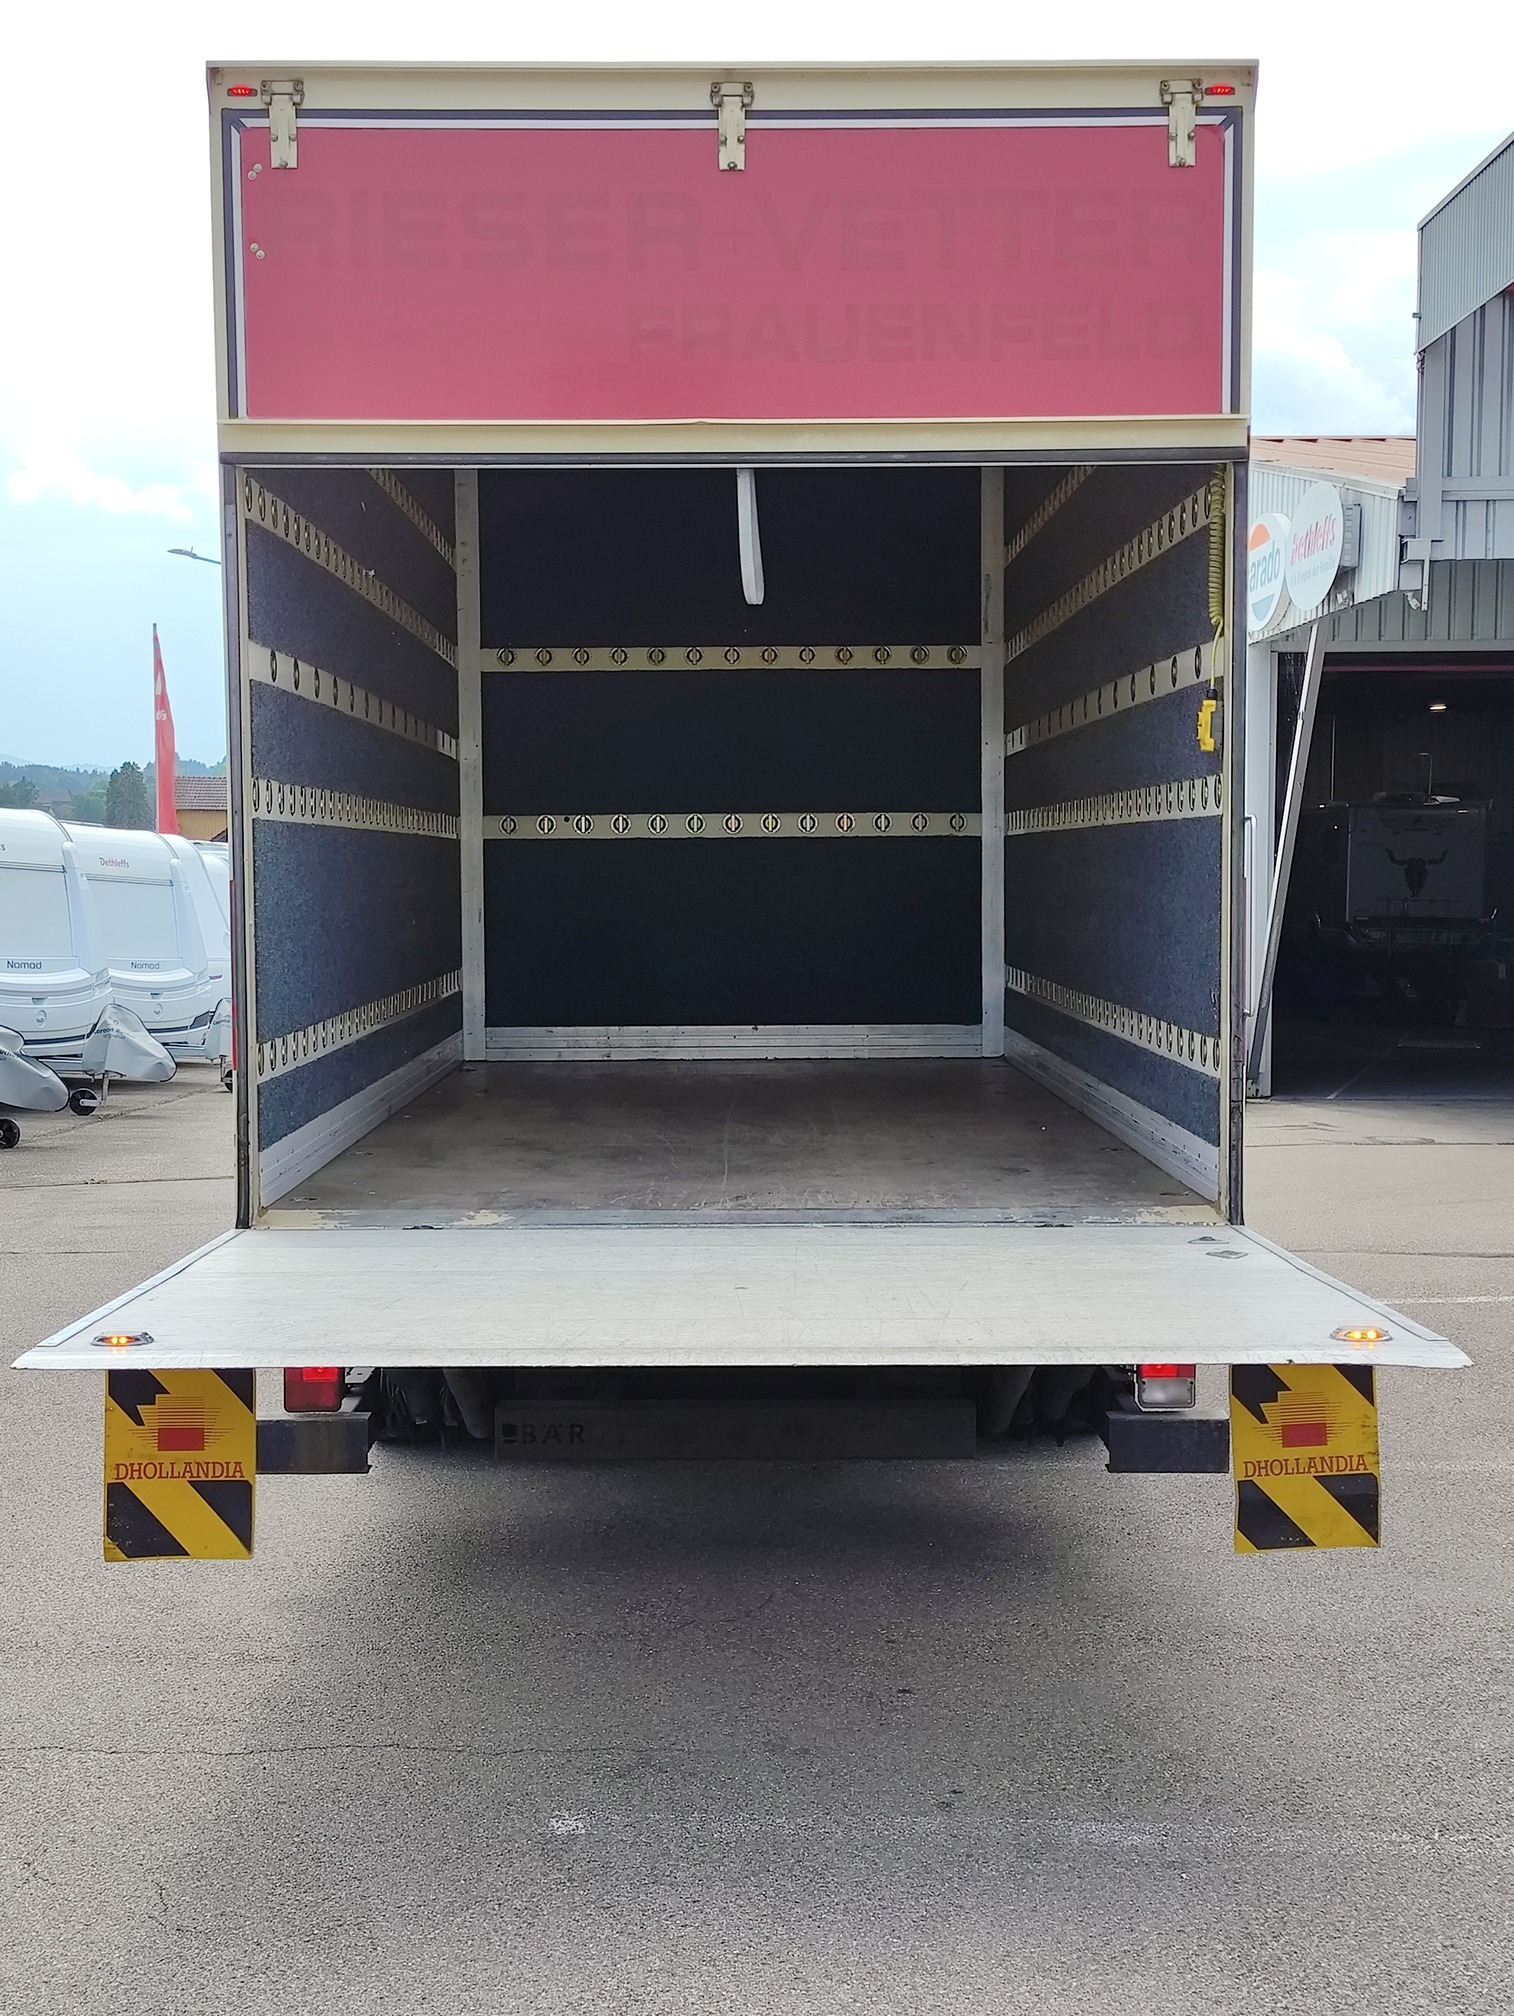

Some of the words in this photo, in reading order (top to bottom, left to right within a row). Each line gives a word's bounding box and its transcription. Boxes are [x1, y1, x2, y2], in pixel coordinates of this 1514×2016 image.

[628, 300, 1204, 362] FRAUENFELD
[1249, 540, 1281, 593] arado
[7, 960, 42, 970] Nomad
[130, 961, 160, 970] Nomad
[521, 1423, 586, 1444] BÄR
[114, 1461, 245, 1480] DHOLLANDIA
[1243, 1454, 1369, 1478] DHOLLANDIA
